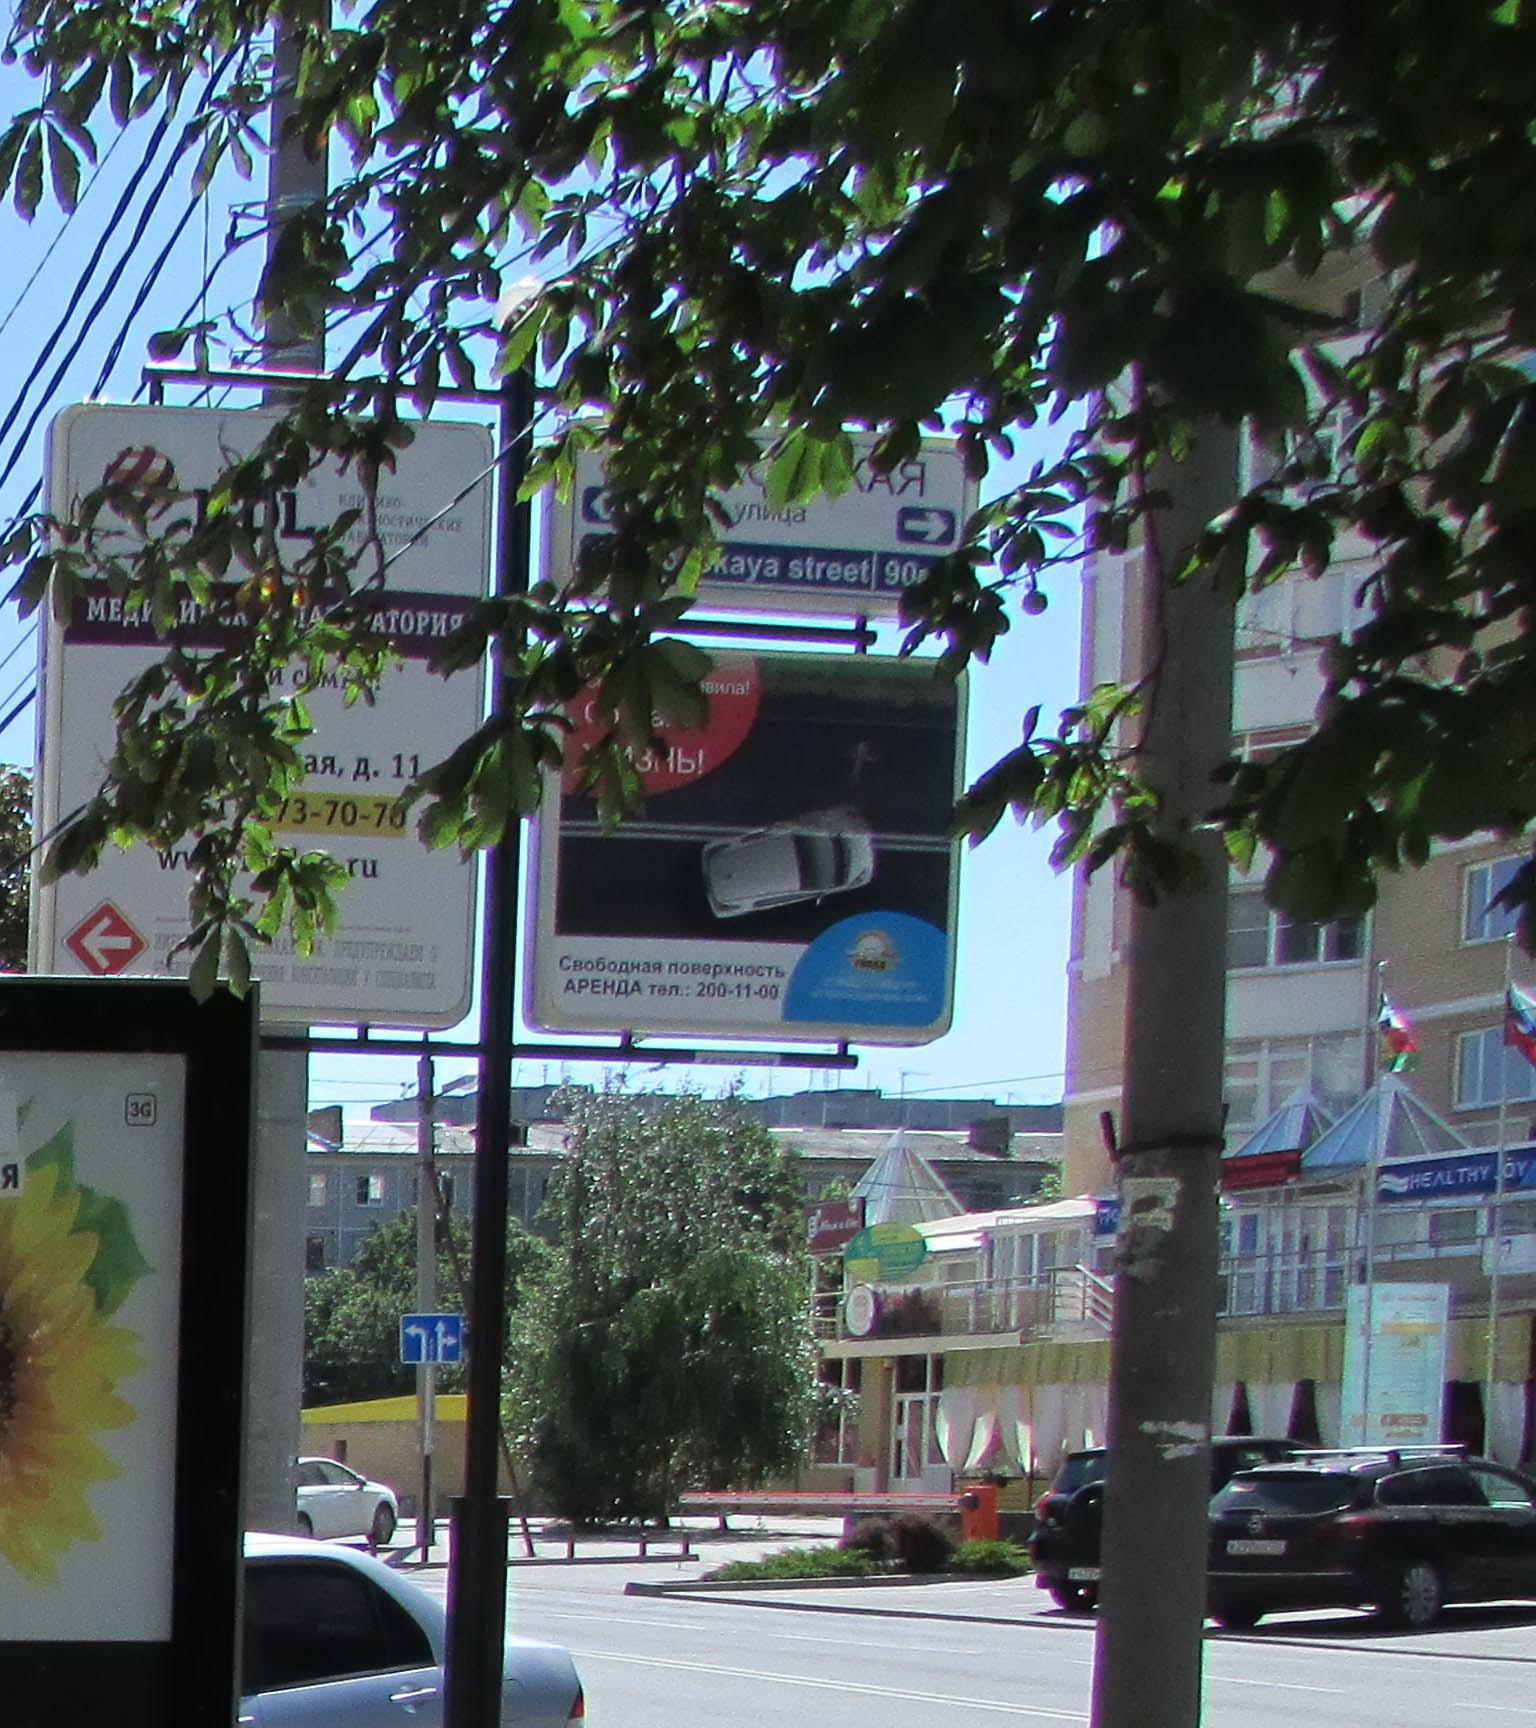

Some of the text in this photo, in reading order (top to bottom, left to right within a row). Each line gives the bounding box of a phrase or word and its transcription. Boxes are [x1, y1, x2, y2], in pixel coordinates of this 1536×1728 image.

[787, 556, 871, 584] street
[391, 753, 421, 780] 11
[558, 955, 785, 981] Свободная поверхность
[563, 979, 642, 997] АРЕНДА
[696, 982, 779, 1000] 200-11-00
